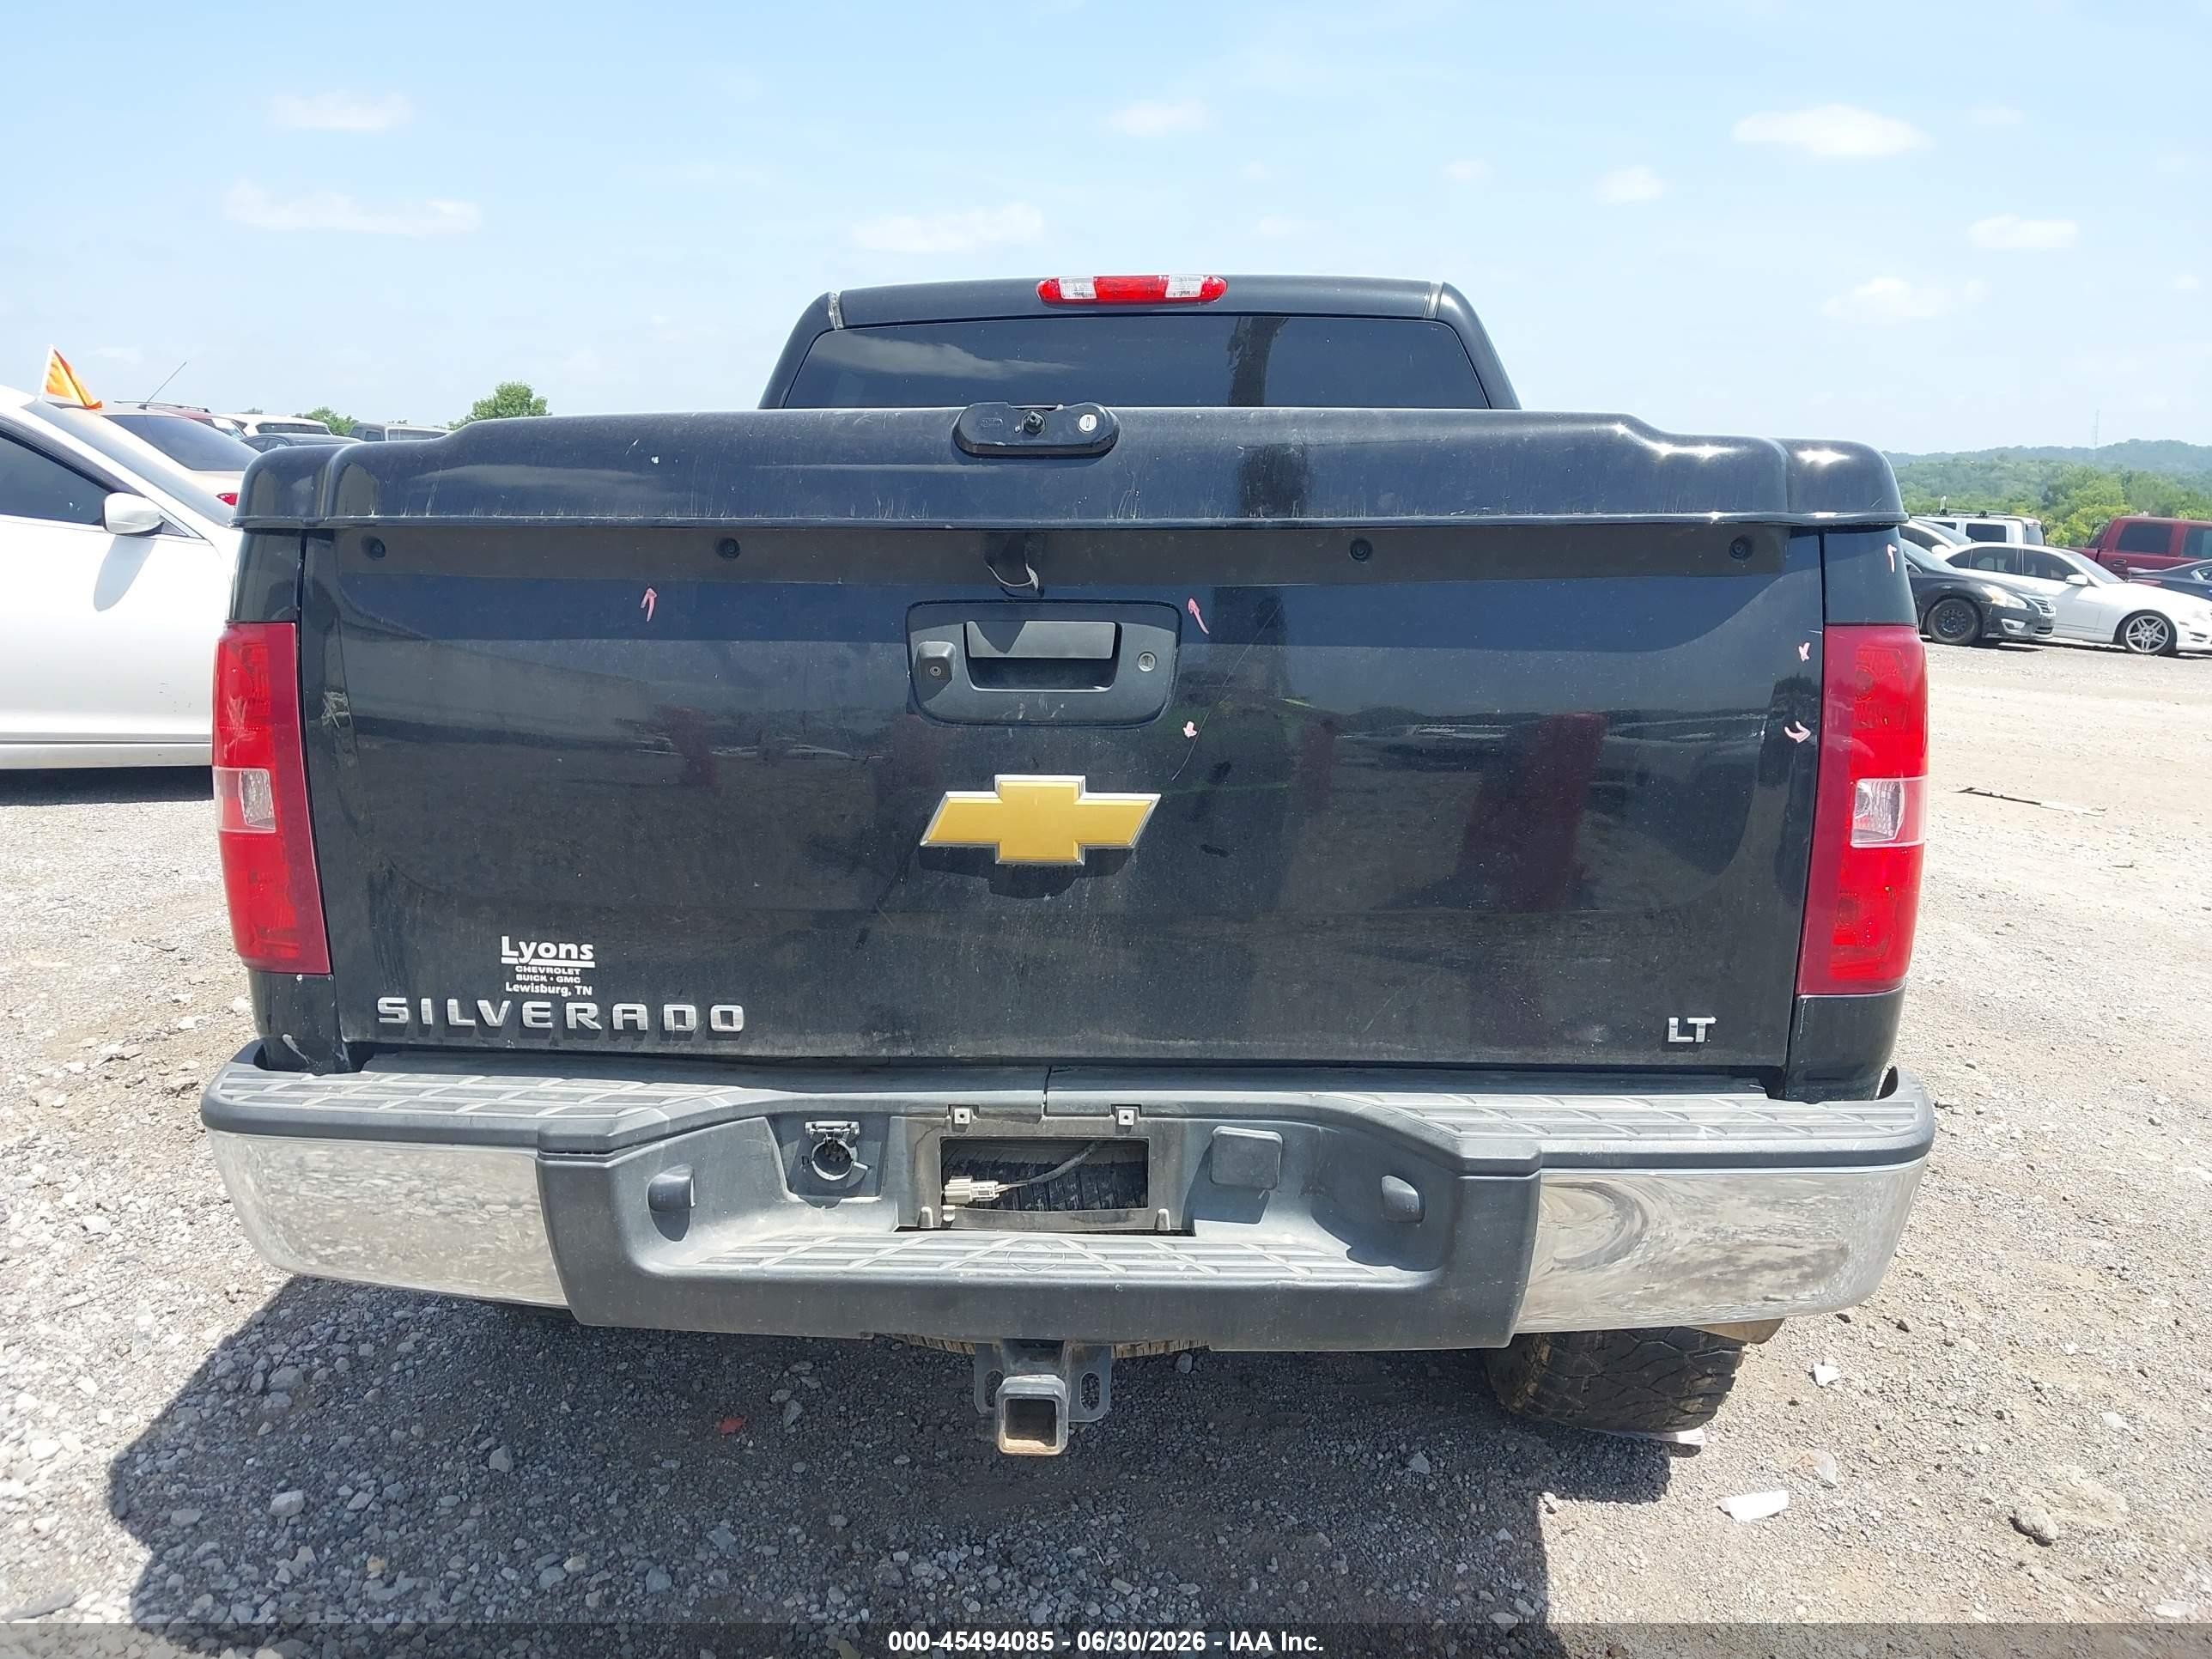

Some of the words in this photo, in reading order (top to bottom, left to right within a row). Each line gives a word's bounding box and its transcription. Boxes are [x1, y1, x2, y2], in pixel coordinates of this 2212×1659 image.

[501, 935, 594, 963] Lyons
[515, 965, 581, 975] CHEVROLET
[516, 974, 548, 982] BUICK
[556, 975, 581, 984] GMC
[505, 981, 572, 997] Lewisburg,
[574, 985, 592, 996] TN
[377, 997, 745, 1032] SILVERADO
[1668, 1017, 1717, 1042] LT
